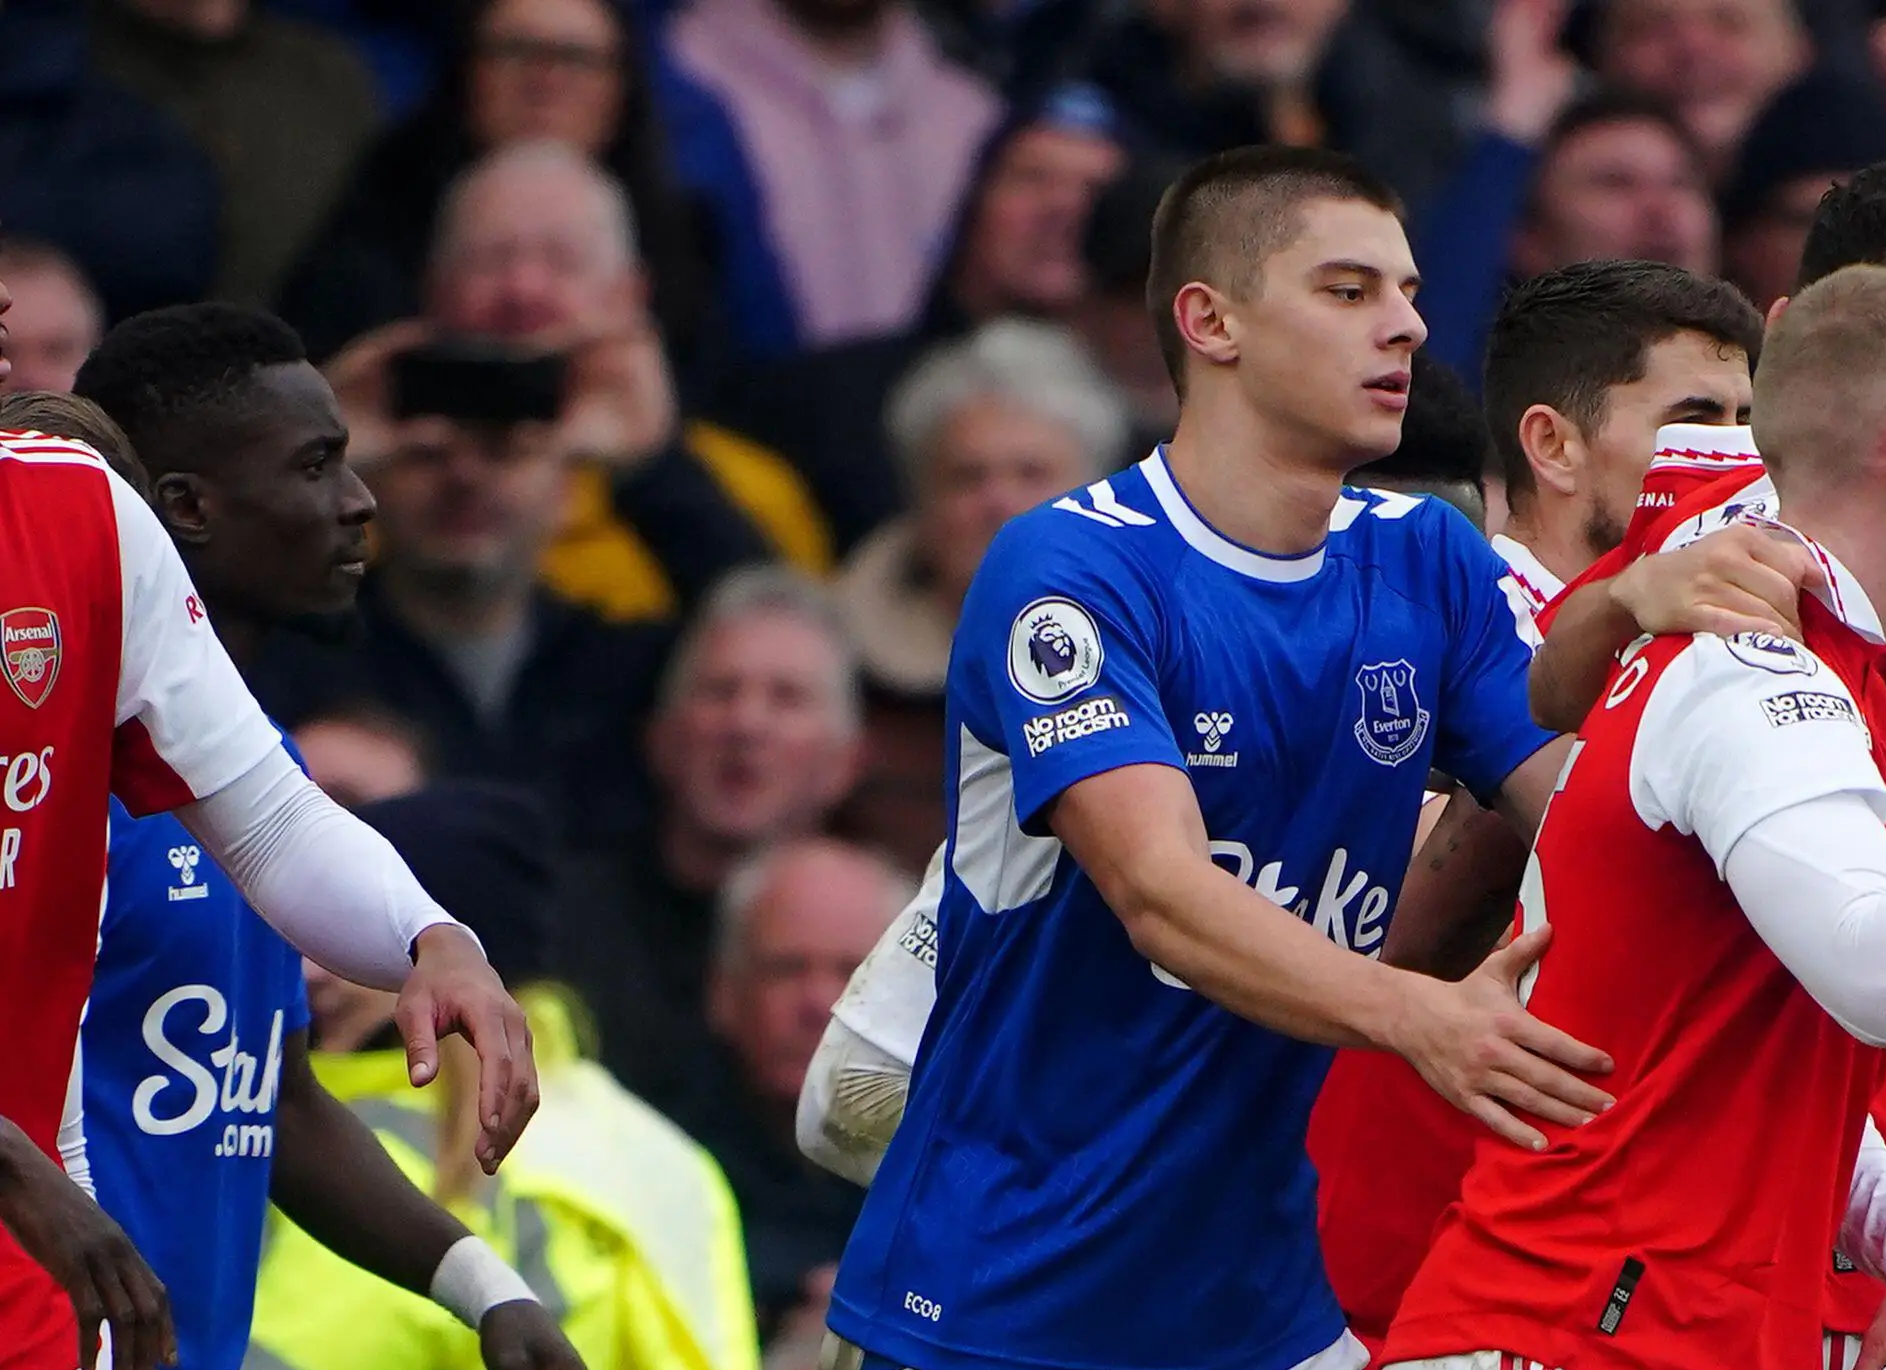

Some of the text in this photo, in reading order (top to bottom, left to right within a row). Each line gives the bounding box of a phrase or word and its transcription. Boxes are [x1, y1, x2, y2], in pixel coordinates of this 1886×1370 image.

[1636, 492, 1676, 508] ENAL
[4, 621, 54, 643] Arsenal
[1760, 694, 1849, 714] No room
[1023, 698, 1116, 738] No room
[1373, 719, 1411, 734] Everton
[1770, 711, 1800, 728] for
[1028, 711, 1130, 758] for racism
[1186, 750, 1239, 768] hummel
[904, 1291, 942, 1322] ECO8
